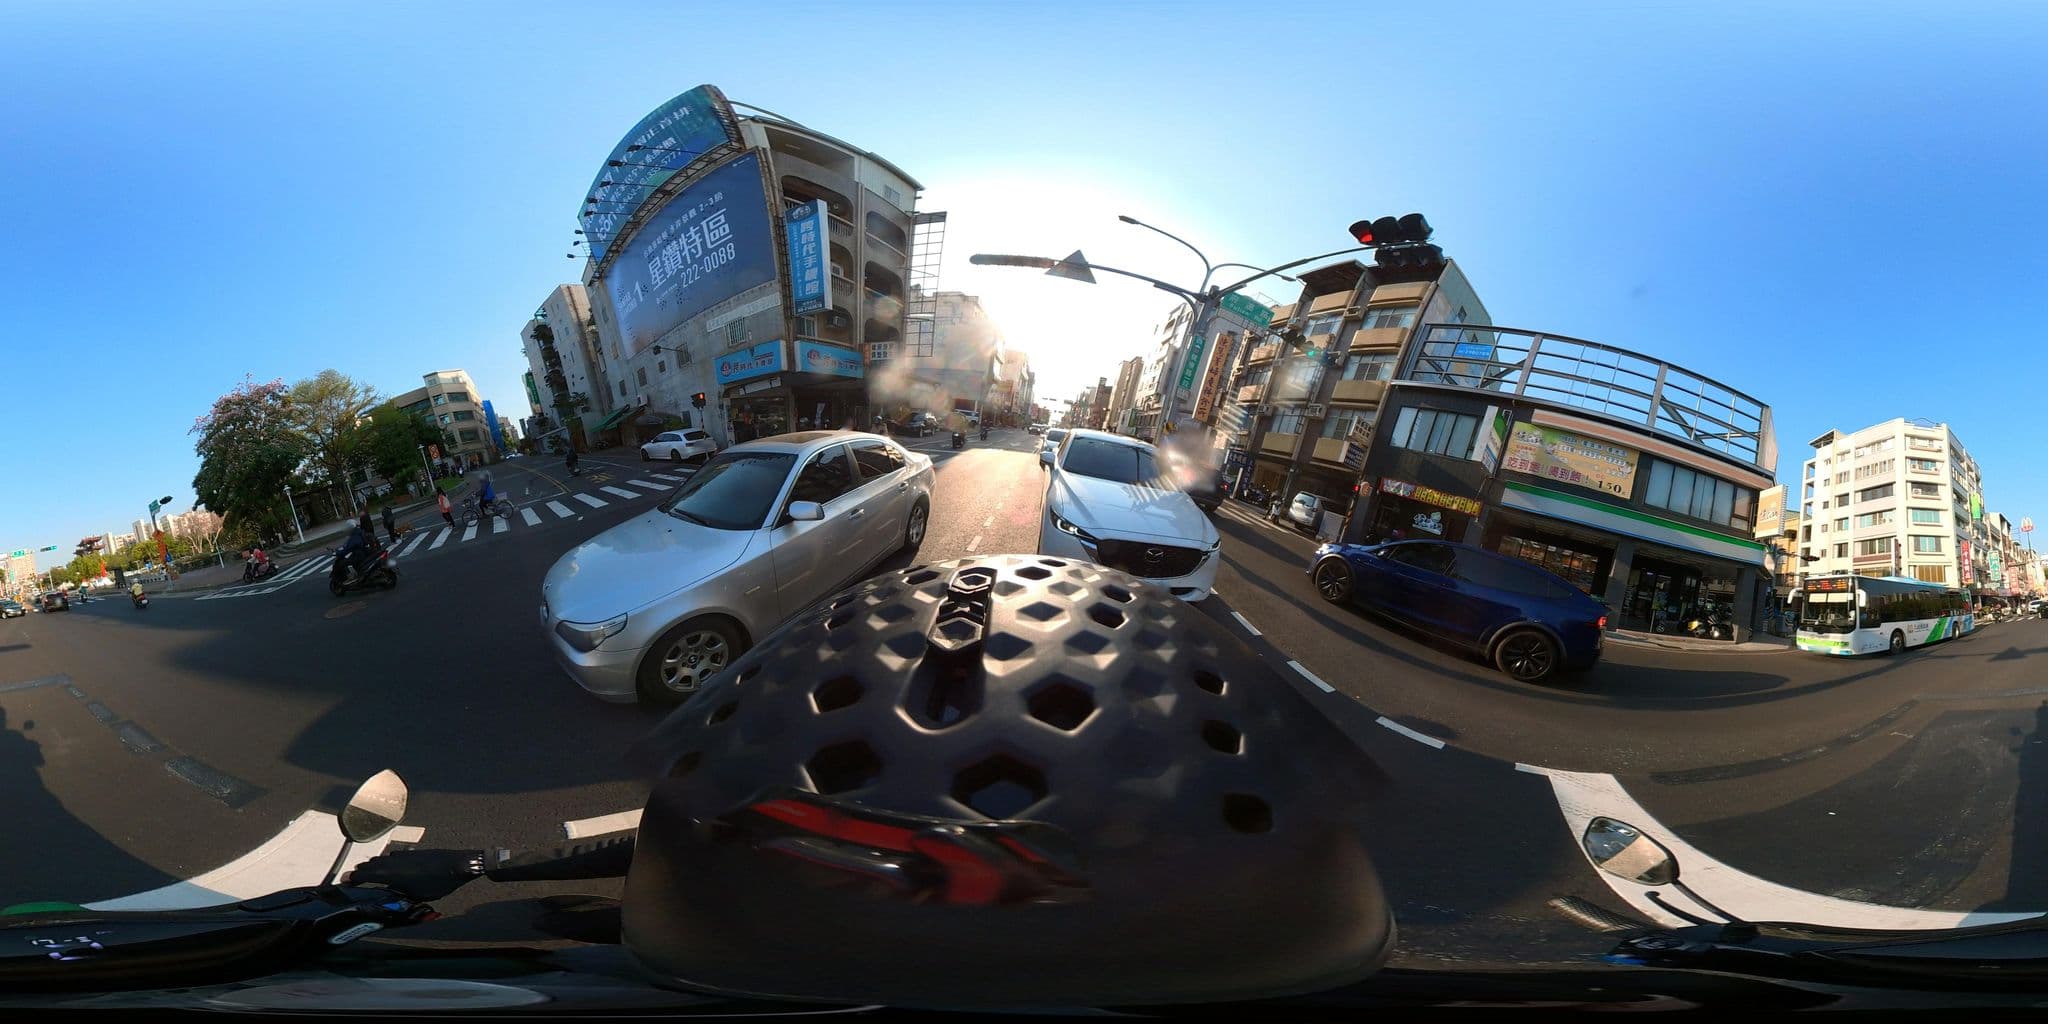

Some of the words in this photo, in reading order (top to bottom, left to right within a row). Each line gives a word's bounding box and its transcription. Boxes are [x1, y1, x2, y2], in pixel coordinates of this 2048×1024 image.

[648, 207, 734, 291] 星鑽特區
[680, 242, 736, 289] 222-0088
